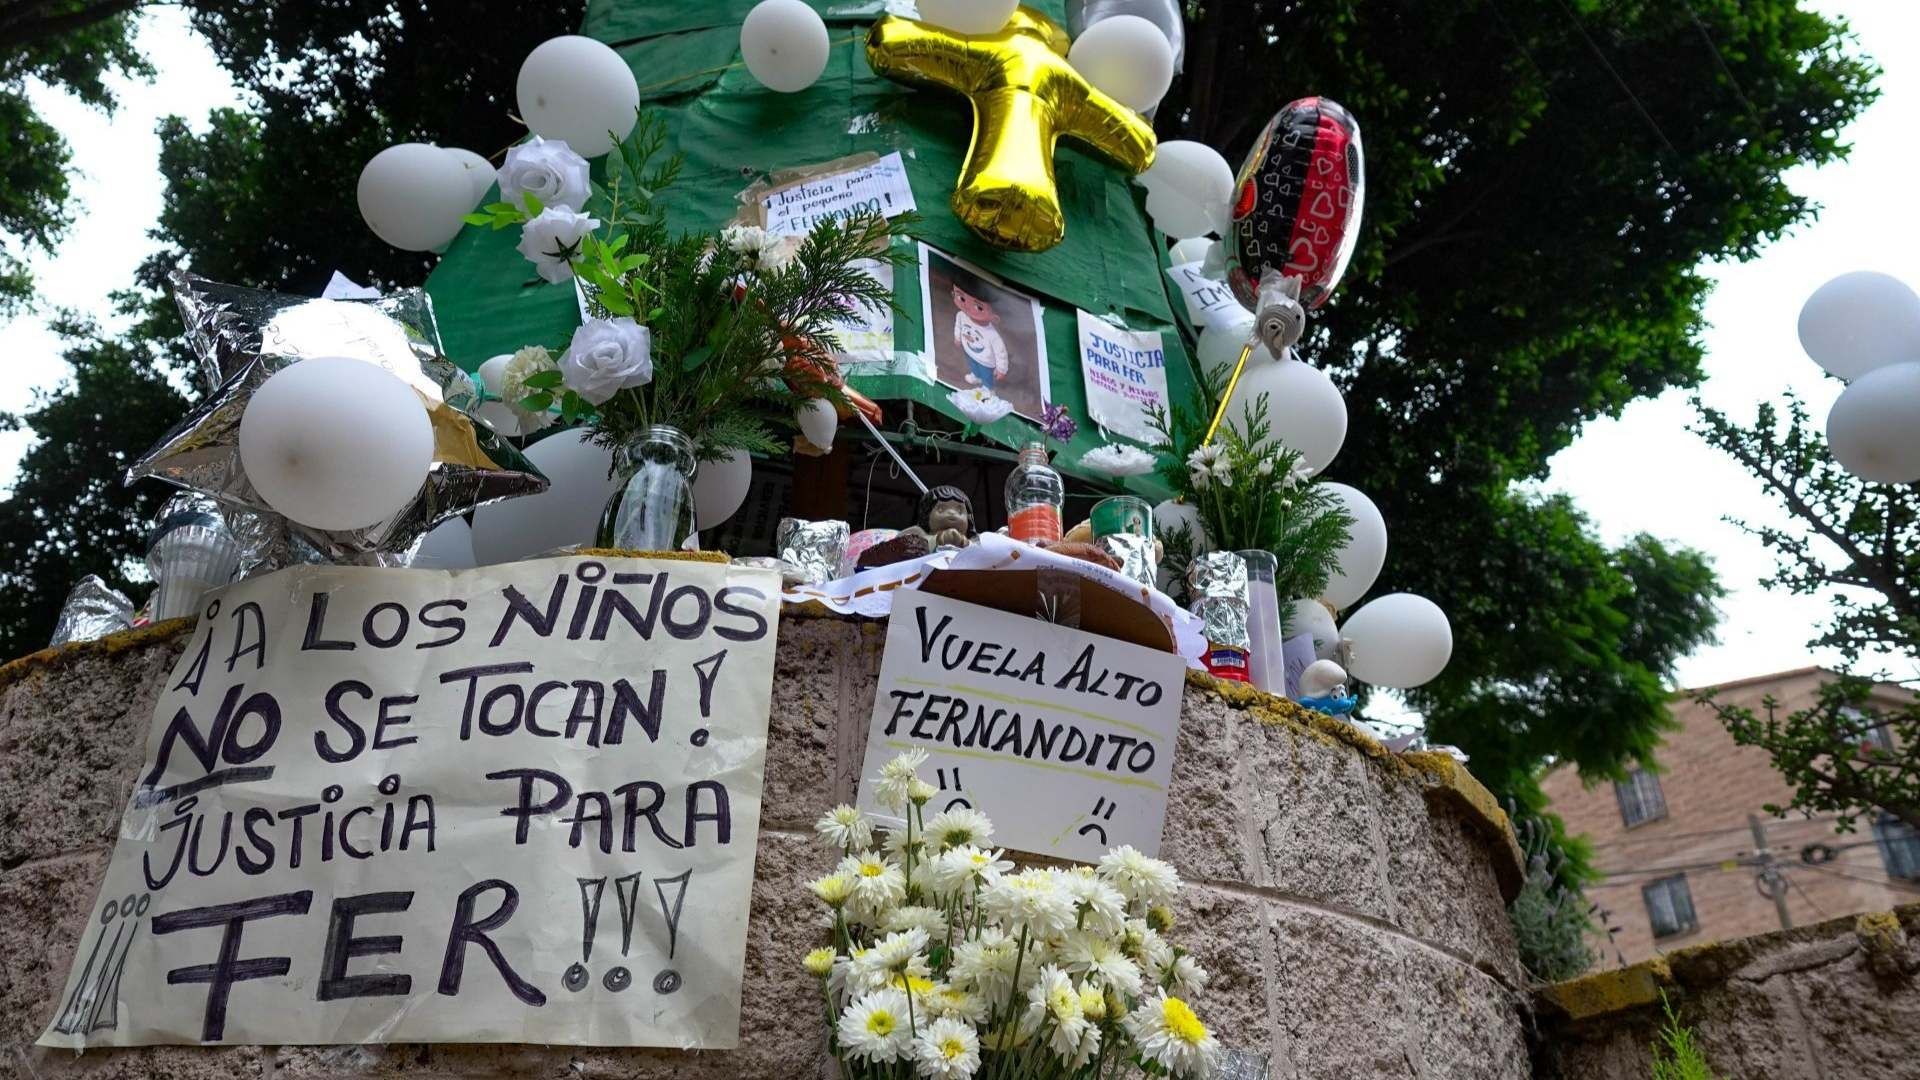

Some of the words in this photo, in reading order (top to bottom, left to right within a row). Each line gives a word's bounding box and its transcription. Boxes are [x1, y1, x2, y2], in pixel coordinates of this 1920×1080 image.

[778, 206, 789, 216] el
[846, 173, 873, 188] para
[1087, 348, 1119, 374] PARA
[1123, 365, 1146, 384] FER
[1090, 332, 1165, 368] JUSTICIA
[302, 591, 467, 652] LOS
[915, 606, 1046, 686] VUELA
[1054, 643, 1163, 707] ALTO
[137, 684, 282, 790] NO
[314, 679, 420, 764] SE
[884, 689, 1156, 774] FERNANDITO
[486, 767, 732, 855] PARA
